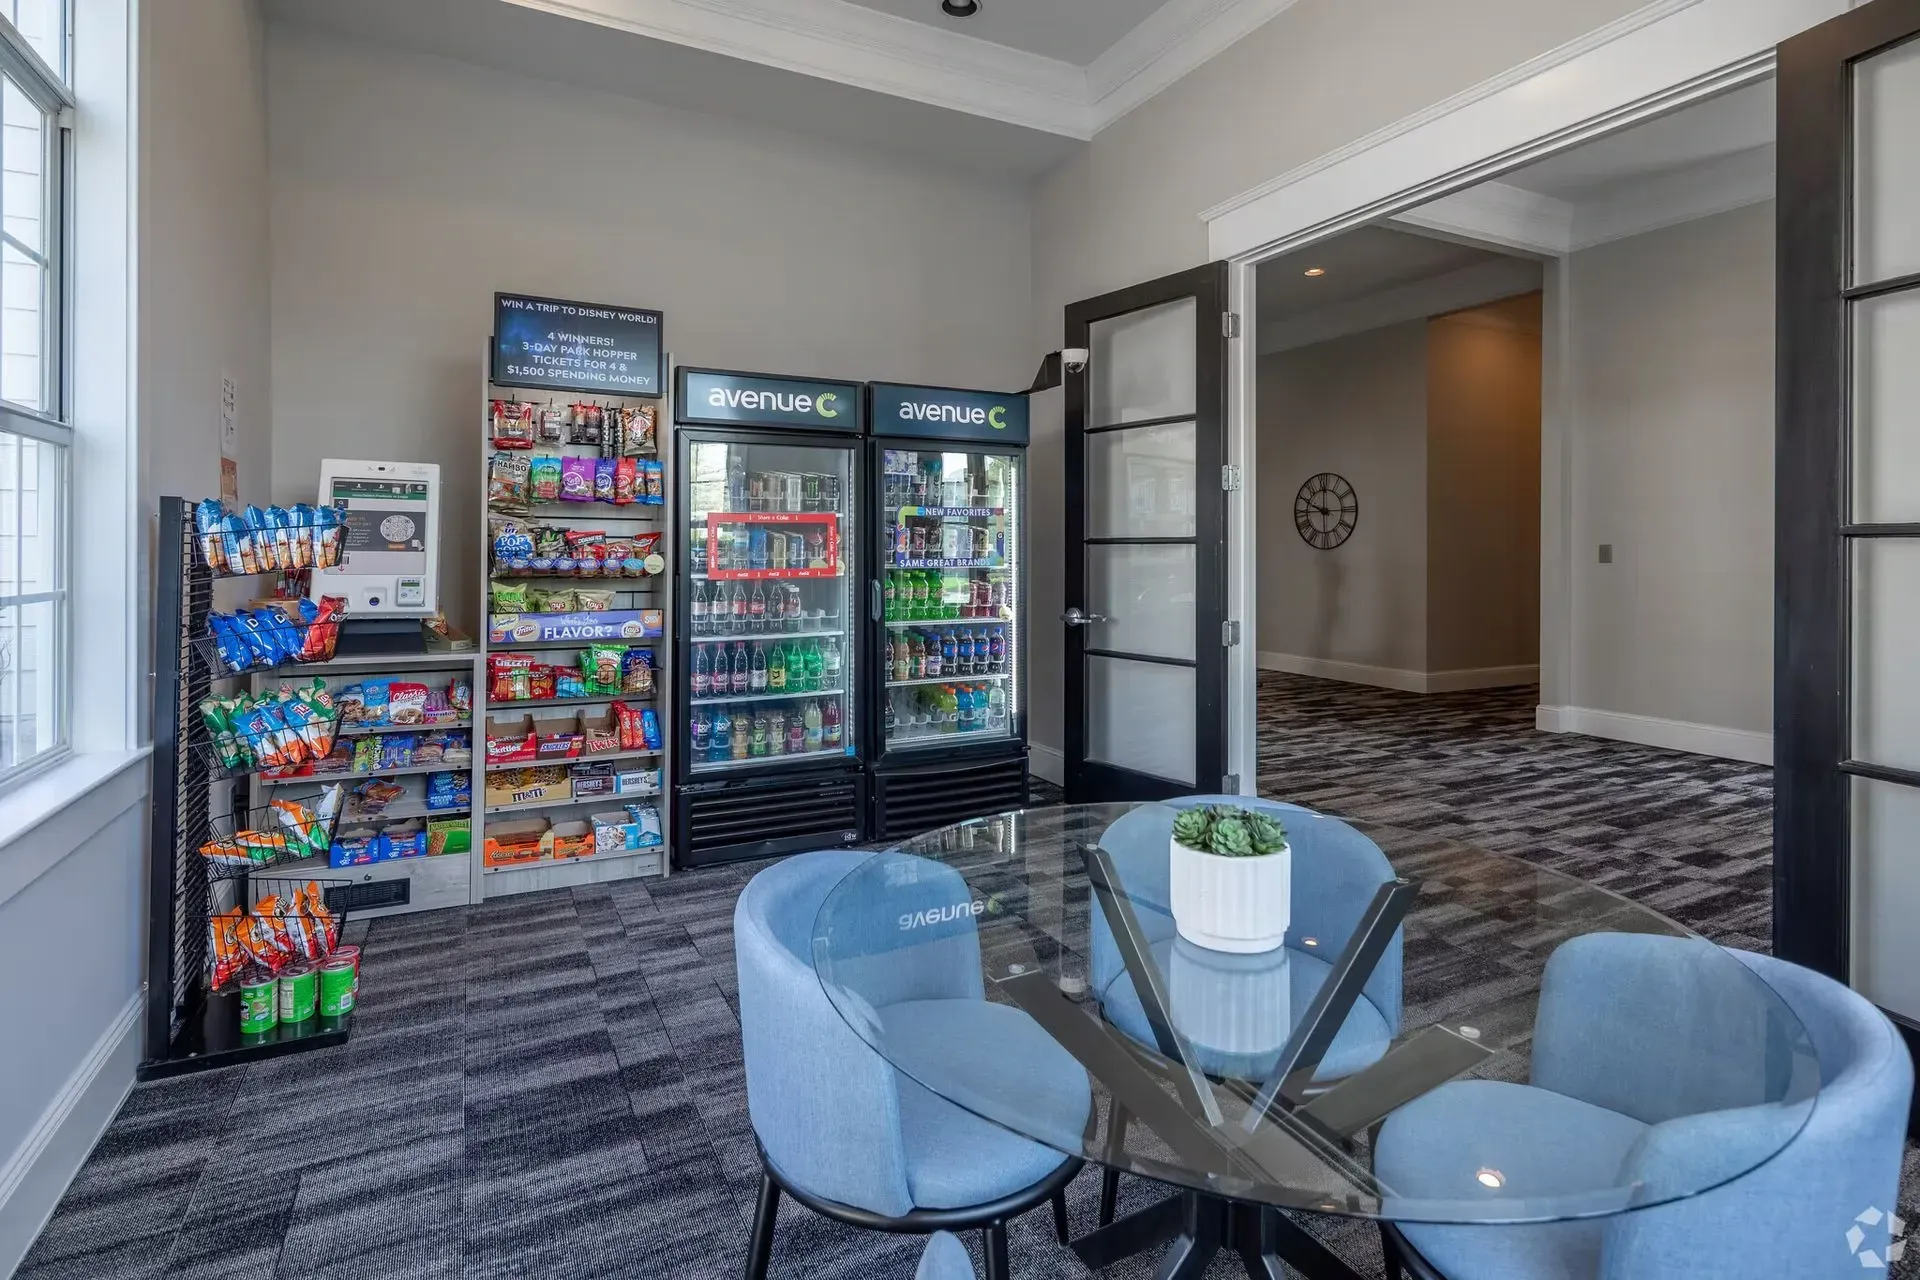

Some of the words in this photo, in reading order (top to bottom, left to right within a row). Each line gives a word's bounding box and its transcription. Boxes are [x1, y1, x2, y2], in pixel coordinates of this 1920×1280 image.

[501, 299, 523, 309] WIN
[526, 303, 534, 311] A
[536, 303, 559, 313] TRIP
[562, 306, 576, 315] TO
[579, 309, 616, 319] DISNEY
[618, 313, 657, 324] WORLD!
[547, 332, 555, 341] 4
[557, 333, 614, 346] WINNERS!
[522, 341, 558, 353] 3-DAY
[560, 346, 590, 356] PARK
[593, 349, 637, 361] HOPPER
[532, 355, 581, 368] TICKETS
[584, 360, 606, 371] FOR
[609, 363, 617, 372] 4
[619, 363, 628, 372] &
[507, 365, 545, 377] $1,500
[547, 369, 606, 382] SPENDING
[609, 374, 651, 385] MONEY
[709, 387, 812, 414] avenue
[899, 401, 985, 425] avenue
[925, 508, 944, 516] NEW
[947, 508, 991, 516] FAVORITES
[501, 537, 524, 546] POP
[900, 559, 925, 567] SAME
[927, 559, 954, 567] GREAT
[957, 559, 990, 567] BRANDS
[544, 626, 613, 639] FLAVOR?
[490, 742, 522, 755] Skittles
